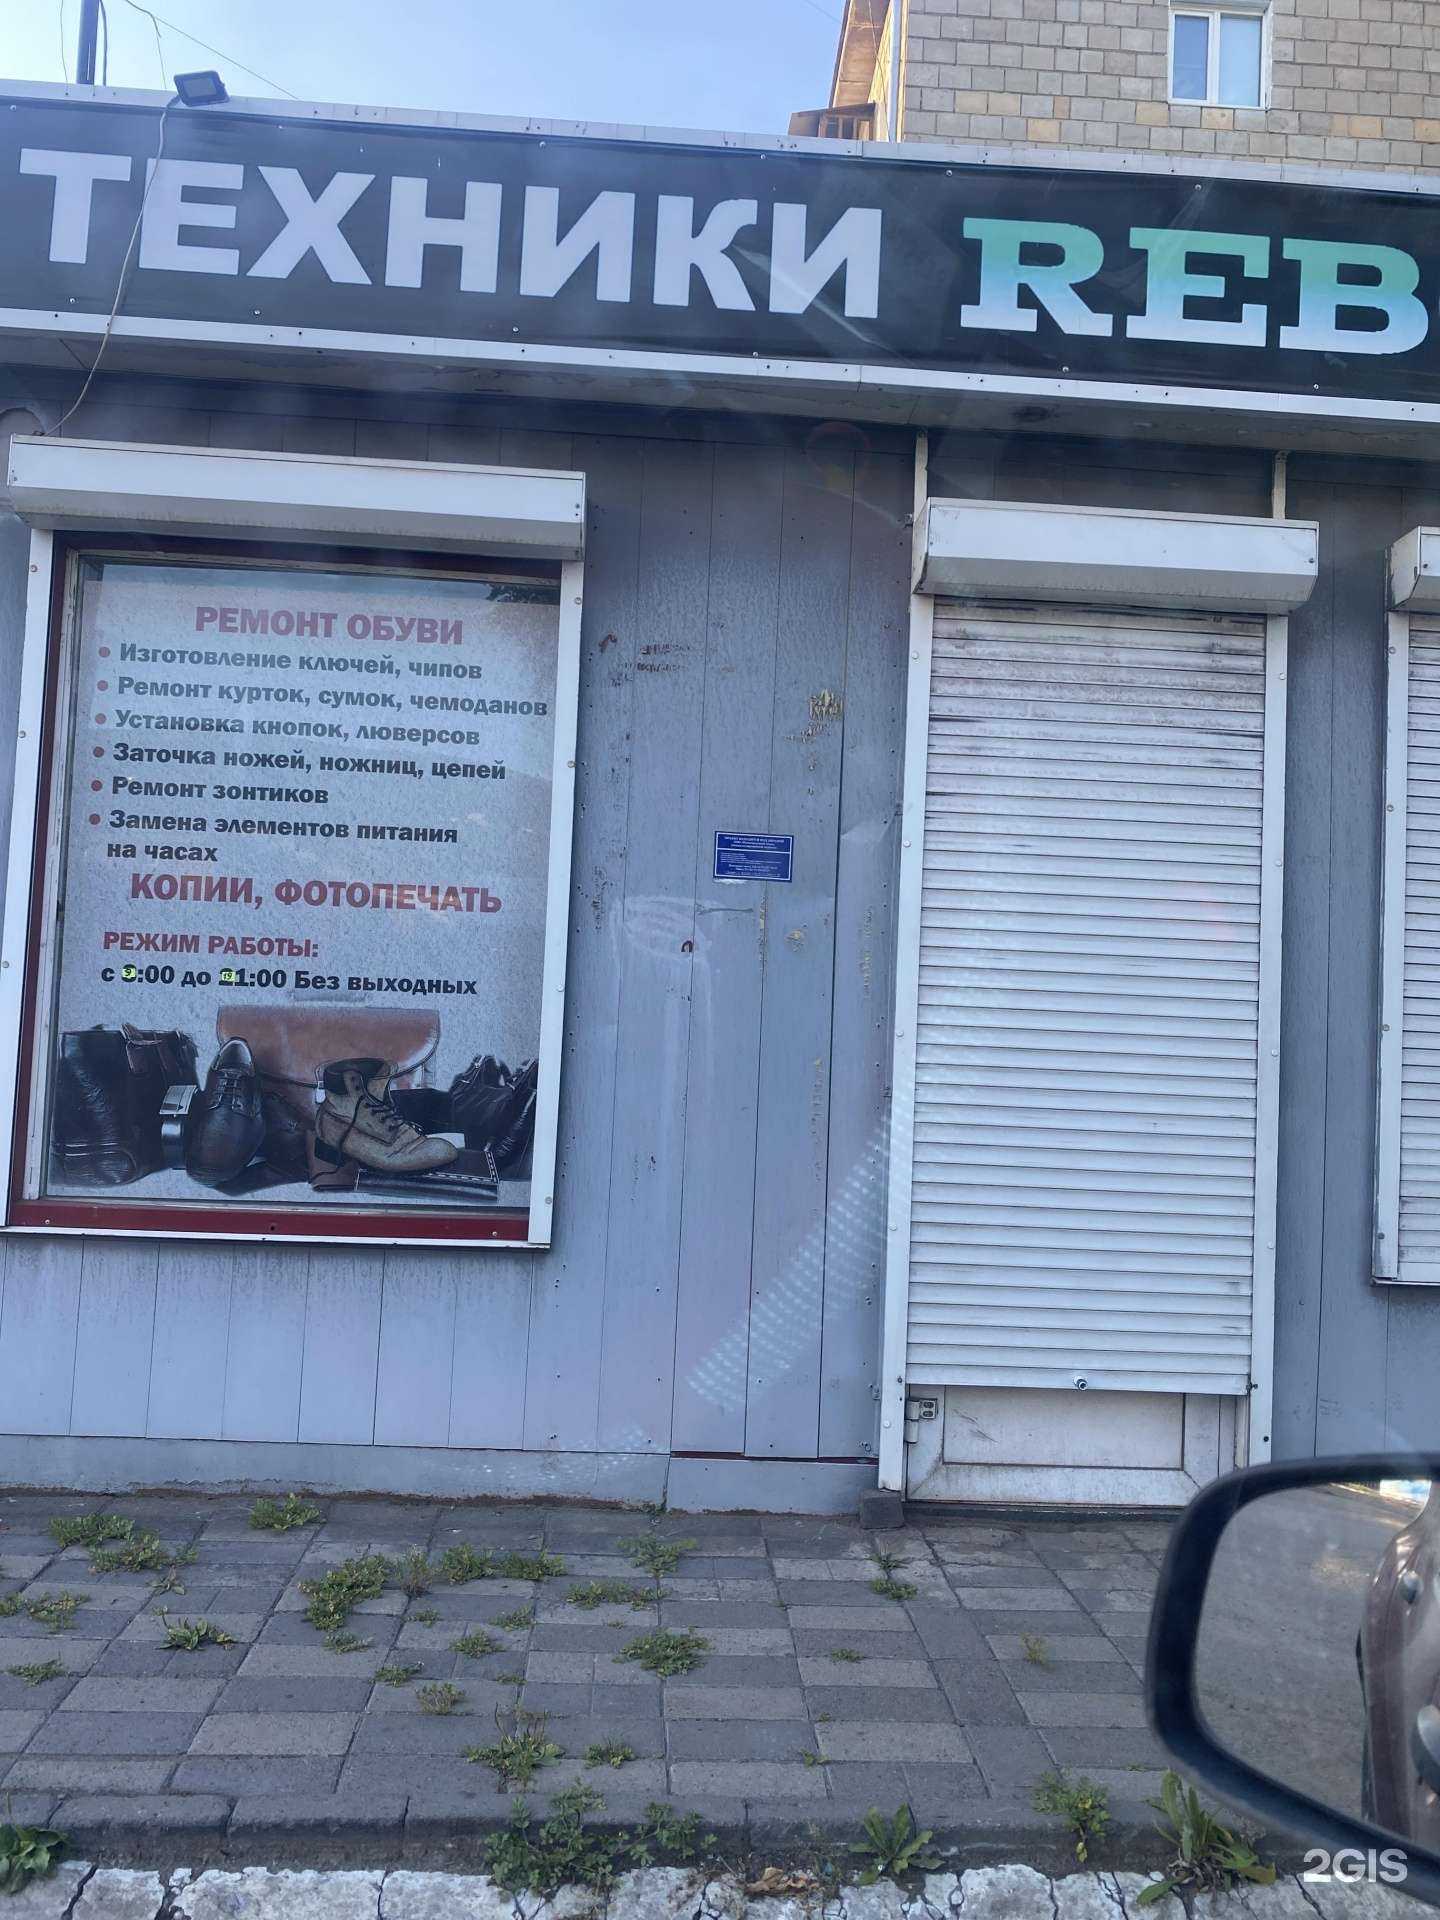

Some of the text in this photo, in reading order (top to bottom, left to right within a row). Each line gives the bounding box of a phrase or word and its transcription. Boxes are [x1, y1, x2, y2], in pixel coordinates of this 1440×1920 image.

[19, 147, 1429, 355] ТЕХНИКИ REB
[195, 606, 463, 645] РЕМОНТ ОБУВИ
[120, 643, 483, 680] Изготовление ключей, чипов
[118, 676, 548, 717] Ремонт курток, сумок, чемоданов
[115, 710, 480, 746] Установка кнопок, люверсов
[113, 743, 506, 781] Заточка ножей, ножниц, цепей
[112, 776, 329, 805] Ремонт зонтиков
[109, 809, 458, 844] Замена элементов питания
[107, 842, 218, 862] на часах
[131, 873, 502, 914] КОПИИ, ФОТОПЕЧАТЬ
[103, 931, 319, 958] РЕЖИМ РАБОТЫ:
[101, 967, 115, 982] с
[181, 970, 212, 988] до
[294, 970, 341, 992] Без
[347, 975, 478, 996] выходных
